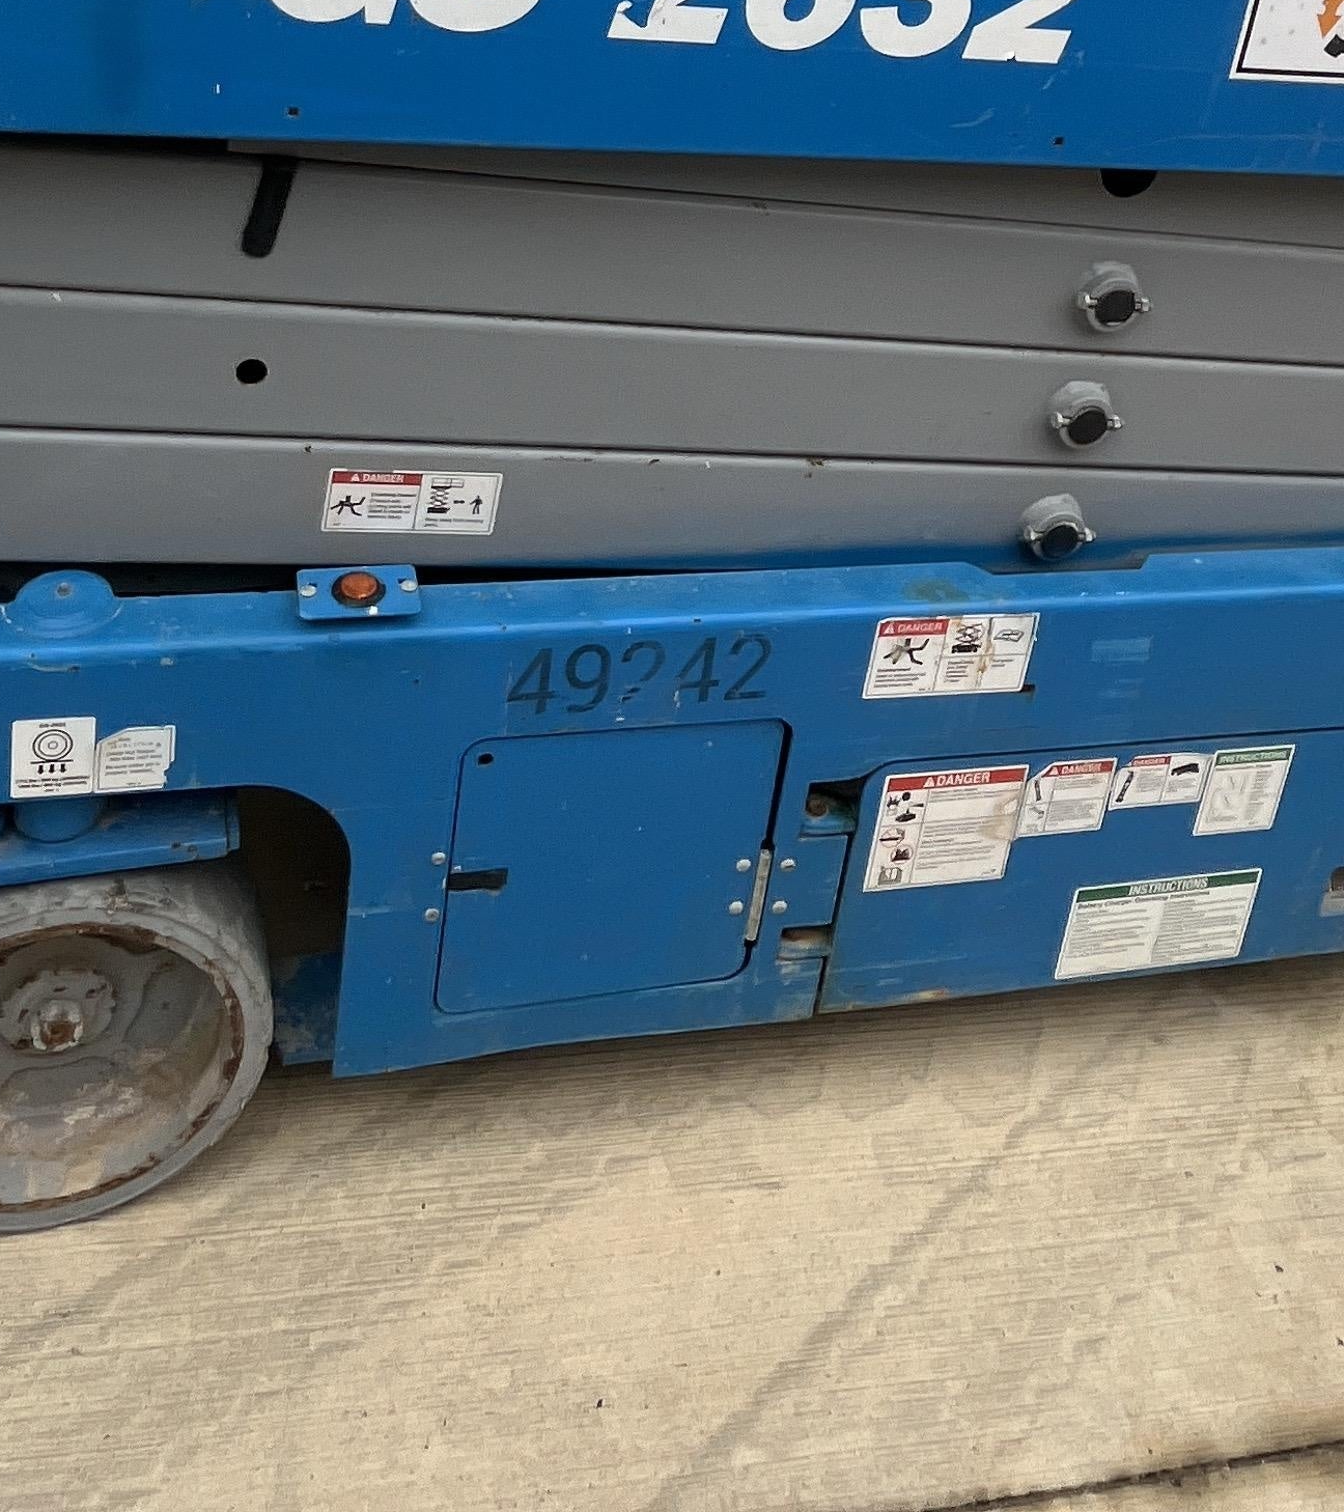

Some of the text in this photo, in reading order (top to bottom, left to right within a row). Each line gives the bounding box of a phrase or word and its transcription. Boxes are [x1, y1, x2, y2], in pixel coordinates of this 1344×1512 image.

[897, 622, 943, 634] DANGER
[506, 633, 773, 715] 49242
[936, 771, 992, 787] DANGER
[1128, 876, 1209, 896] INSTRUCTIONS
